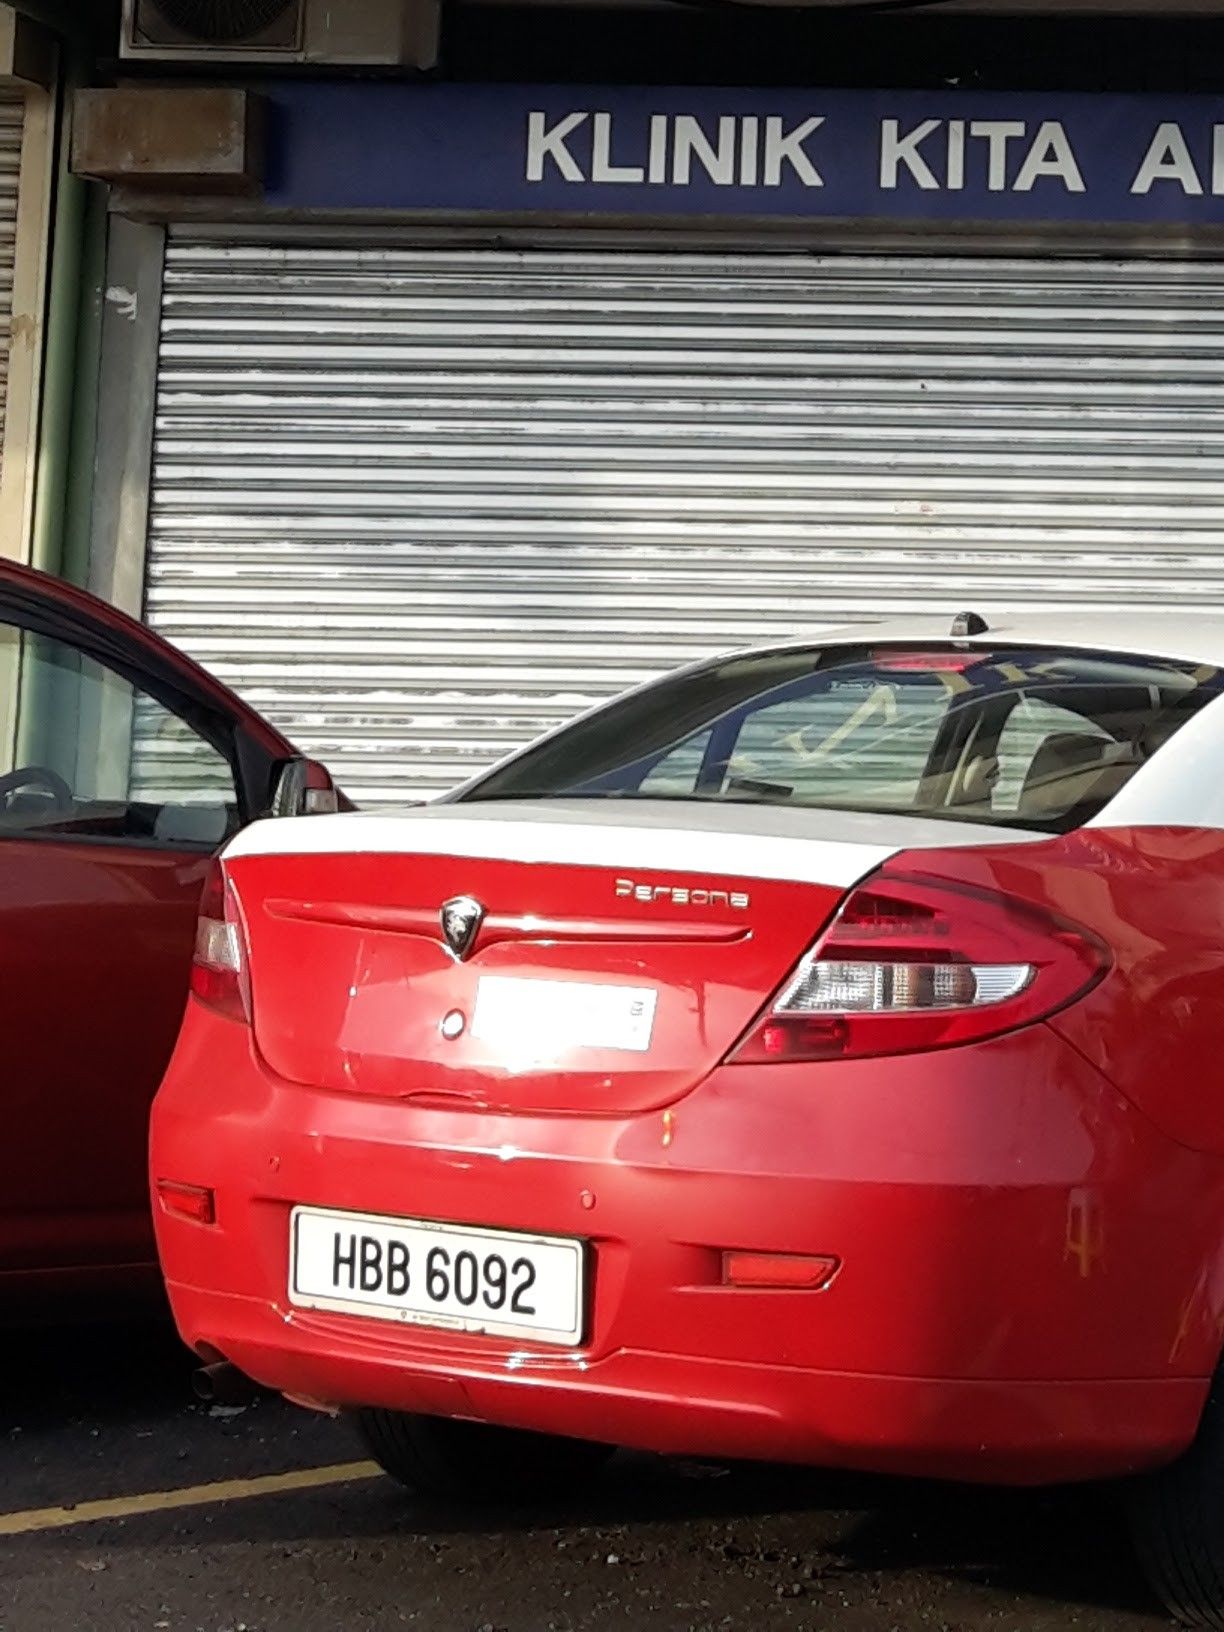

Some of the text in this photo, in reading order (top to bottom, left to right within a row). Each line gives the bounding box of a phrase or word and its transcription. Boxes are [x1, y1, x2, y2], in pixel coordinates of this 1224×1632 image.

[526, 112, 824, 187] KLINIK
[880, 119, 1086, 192] KITA
[615, 878, 750, 909] Persona
[333, 1231, 537, 1316] HBB 6092
